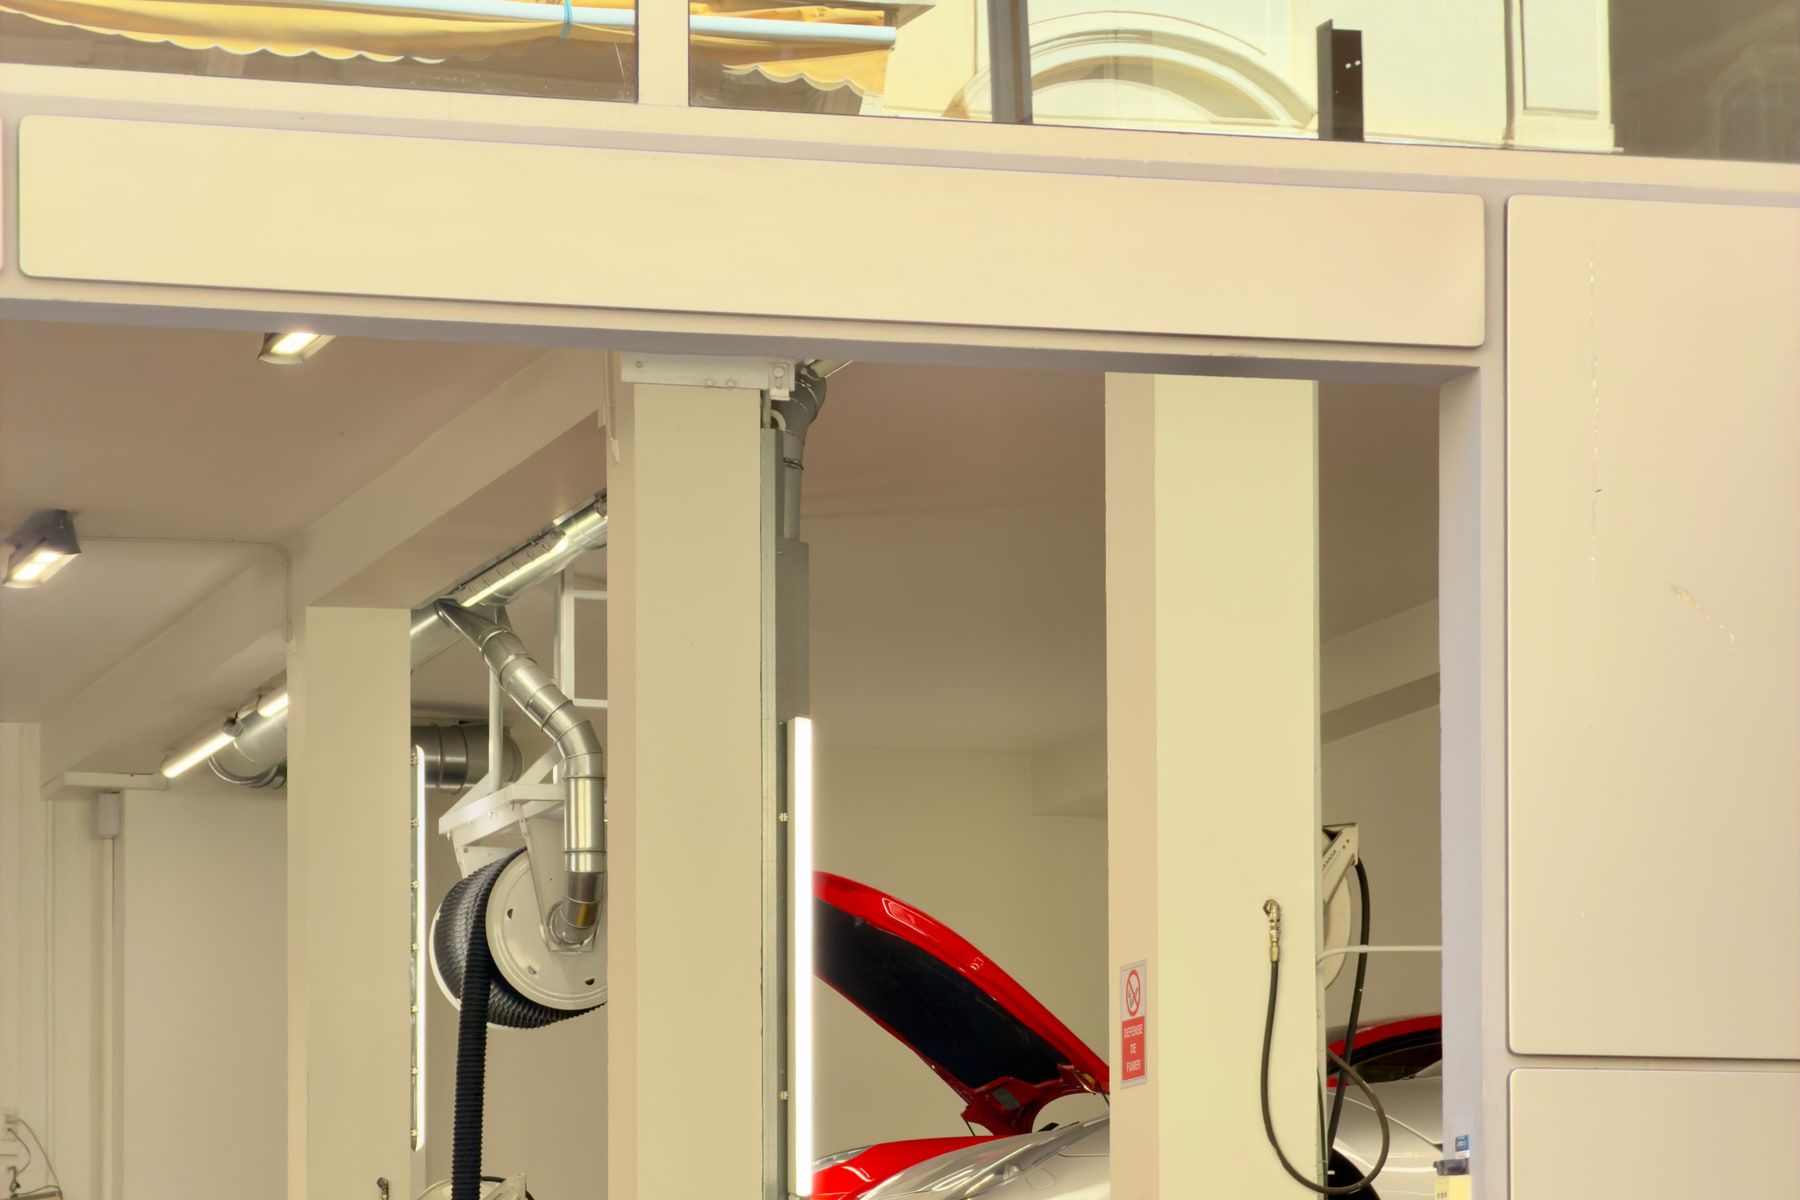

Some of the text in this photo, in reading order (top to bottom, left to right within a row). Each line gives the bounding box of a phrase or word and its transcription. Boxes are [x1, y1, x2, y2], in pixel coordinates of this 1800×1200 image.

[1124, 1024, 1143, 1039] DEFENSE
[1130, 1043, 1137, 1054] DE
[1126, 1059, 1141, 1072] FUMER
